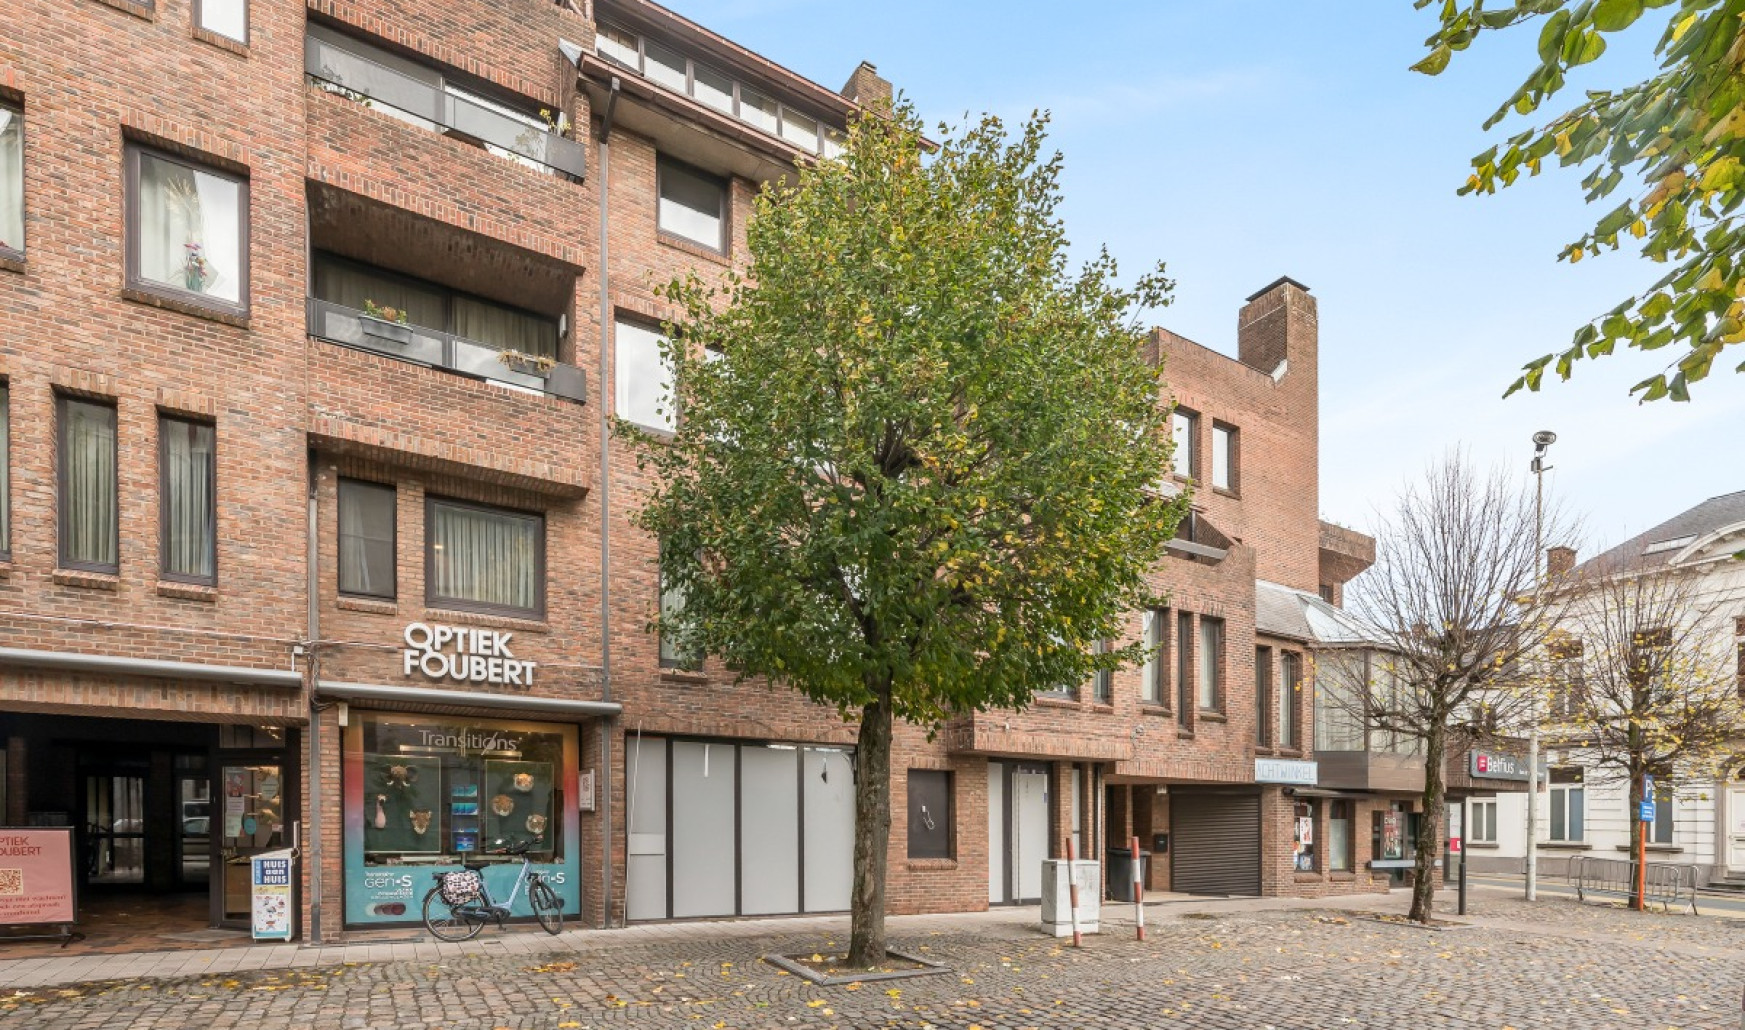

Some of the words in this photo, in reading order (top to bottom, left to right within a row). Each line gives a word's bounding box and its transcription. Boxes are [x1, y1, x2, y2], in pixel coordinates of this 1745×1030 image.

[404, 622, 514, 658] OPTIEK
[403, 649, 537, 686] FOUBERT
[419, 730, 517, 754] Transitions
[1487, 757, 1514, 774] Belfius
[1645, 779, 1652, 798] P
[263, 860, 286, 868] HUIS
[263, 875, 286, 884] HUIS
